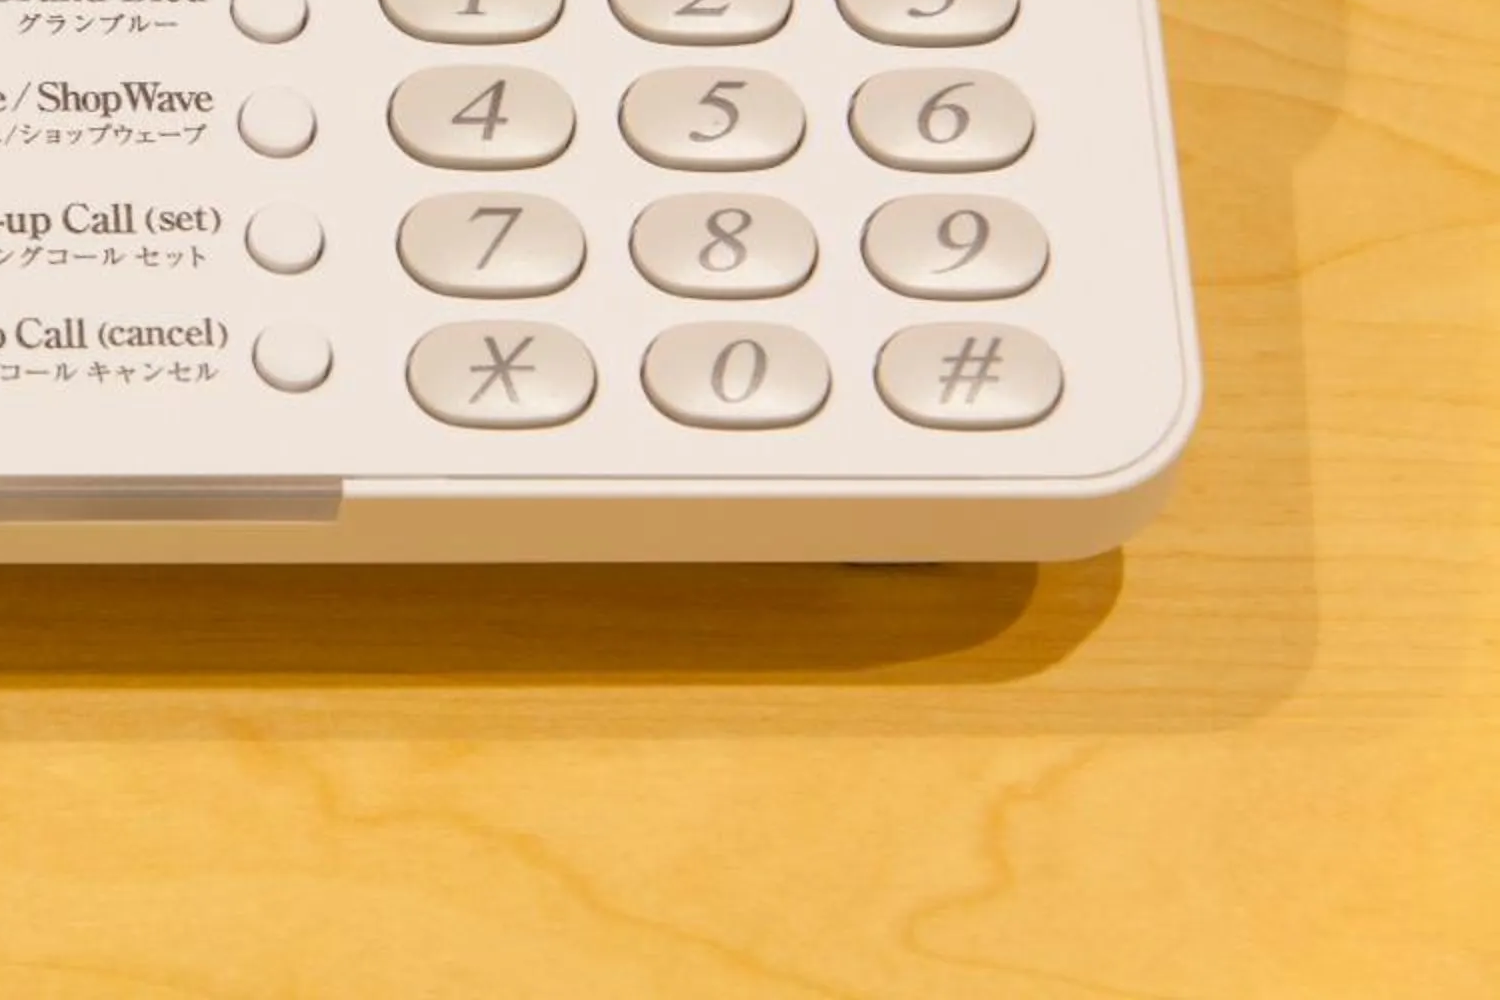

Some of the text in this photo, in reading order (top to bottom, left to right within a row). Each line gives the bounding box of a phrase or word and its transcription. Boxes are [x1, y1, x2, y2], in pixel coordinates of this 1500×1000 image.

[19, 12, 178, 36] グランブルー
[451, 79, 509, 141] 4
[688, 80, 748, 143] 5
[916, 81, 975, 145] 6
[61, 202, 137, 235] Call
[144, 206, 222, 235] (set)
[469, 206, 524, 271] 7
[698, 207, 753, 273] 8
[934, 209, 991, 274] 9
[134, 245, 206, 269] セット
[15, 317, 89, 350] Call
[97, 316, 229, 350] (cancel)
[86, 360, 219, 385] キャンセル
[710, 338, 768, 404] 0
[938, 336, 1004, 404] #
